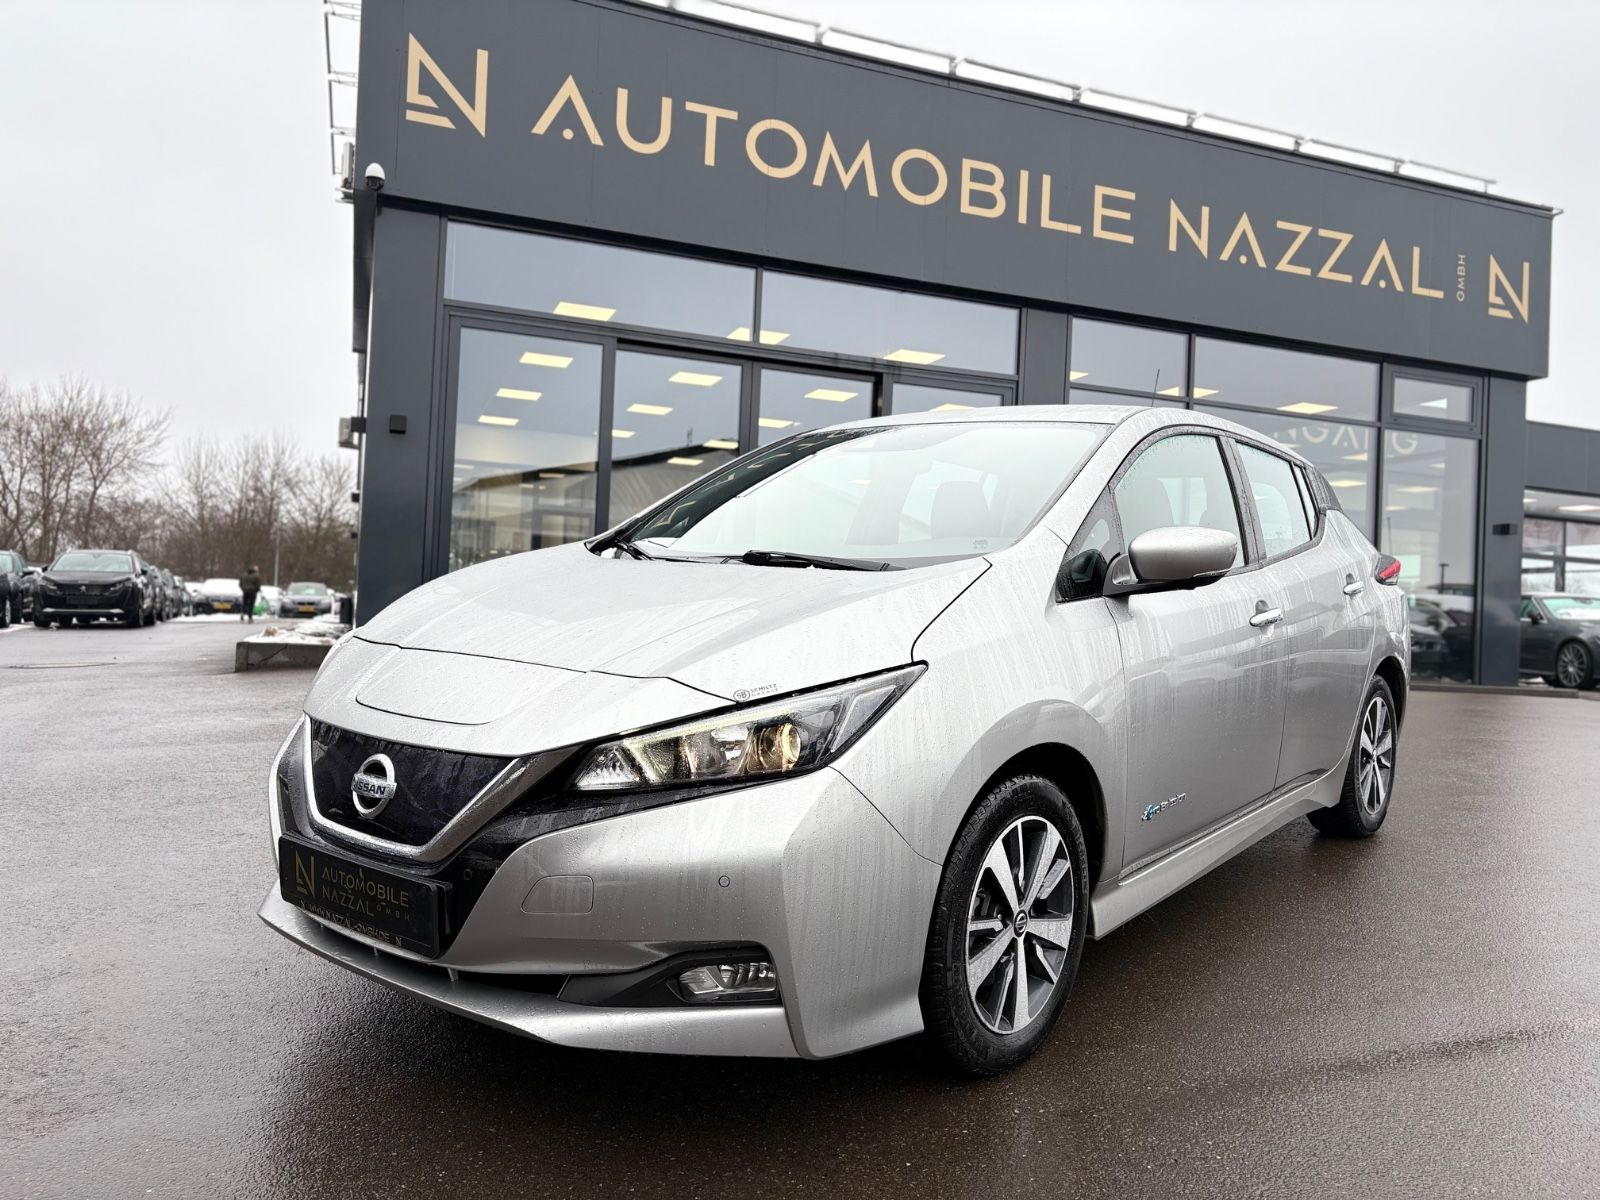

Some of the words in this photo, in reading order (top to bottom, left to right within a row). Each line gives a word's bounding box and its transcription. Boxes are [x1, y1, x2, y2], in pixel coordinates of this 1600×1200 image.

[531, 74, 1135, 244] AUTOMOBILE
[1169, 198, 1444, 300] NAZZAL
[321, 866, 409, 908] AUTOMOBILE
[322, 885, 375, 917] NAZZAL
